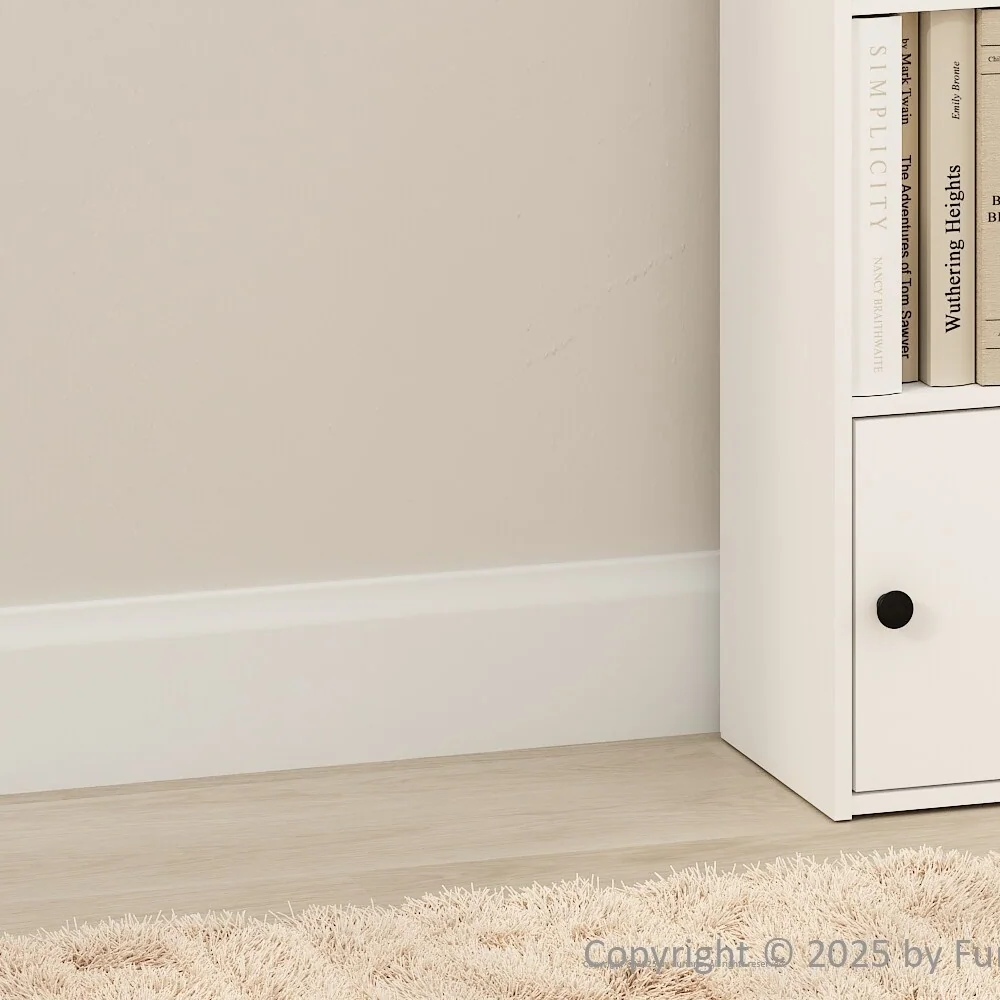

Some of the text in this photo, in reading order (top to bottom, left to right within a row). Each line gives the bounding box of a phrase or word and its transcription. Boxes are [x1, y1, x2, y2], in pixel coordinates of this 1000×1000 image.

[902, 53, 912, 85] Mark
[951, 61, 962, 120] Emily Bronte
[902, 88, 912, 125] Twain
[869, 45, 887, 230] SIMPLICITY
[902, 154, 912, 180] The
[902, 184, 912, 258] Adventures
[902, 262, 912, 275] of
[945, 164, 964, 333] Wuthering Heights
[873, 257, 883, 373] NANCY BRAITHWAITE
[902, 278, 912, 306] Tom
[902, 310, 912, 359] Sawyer
